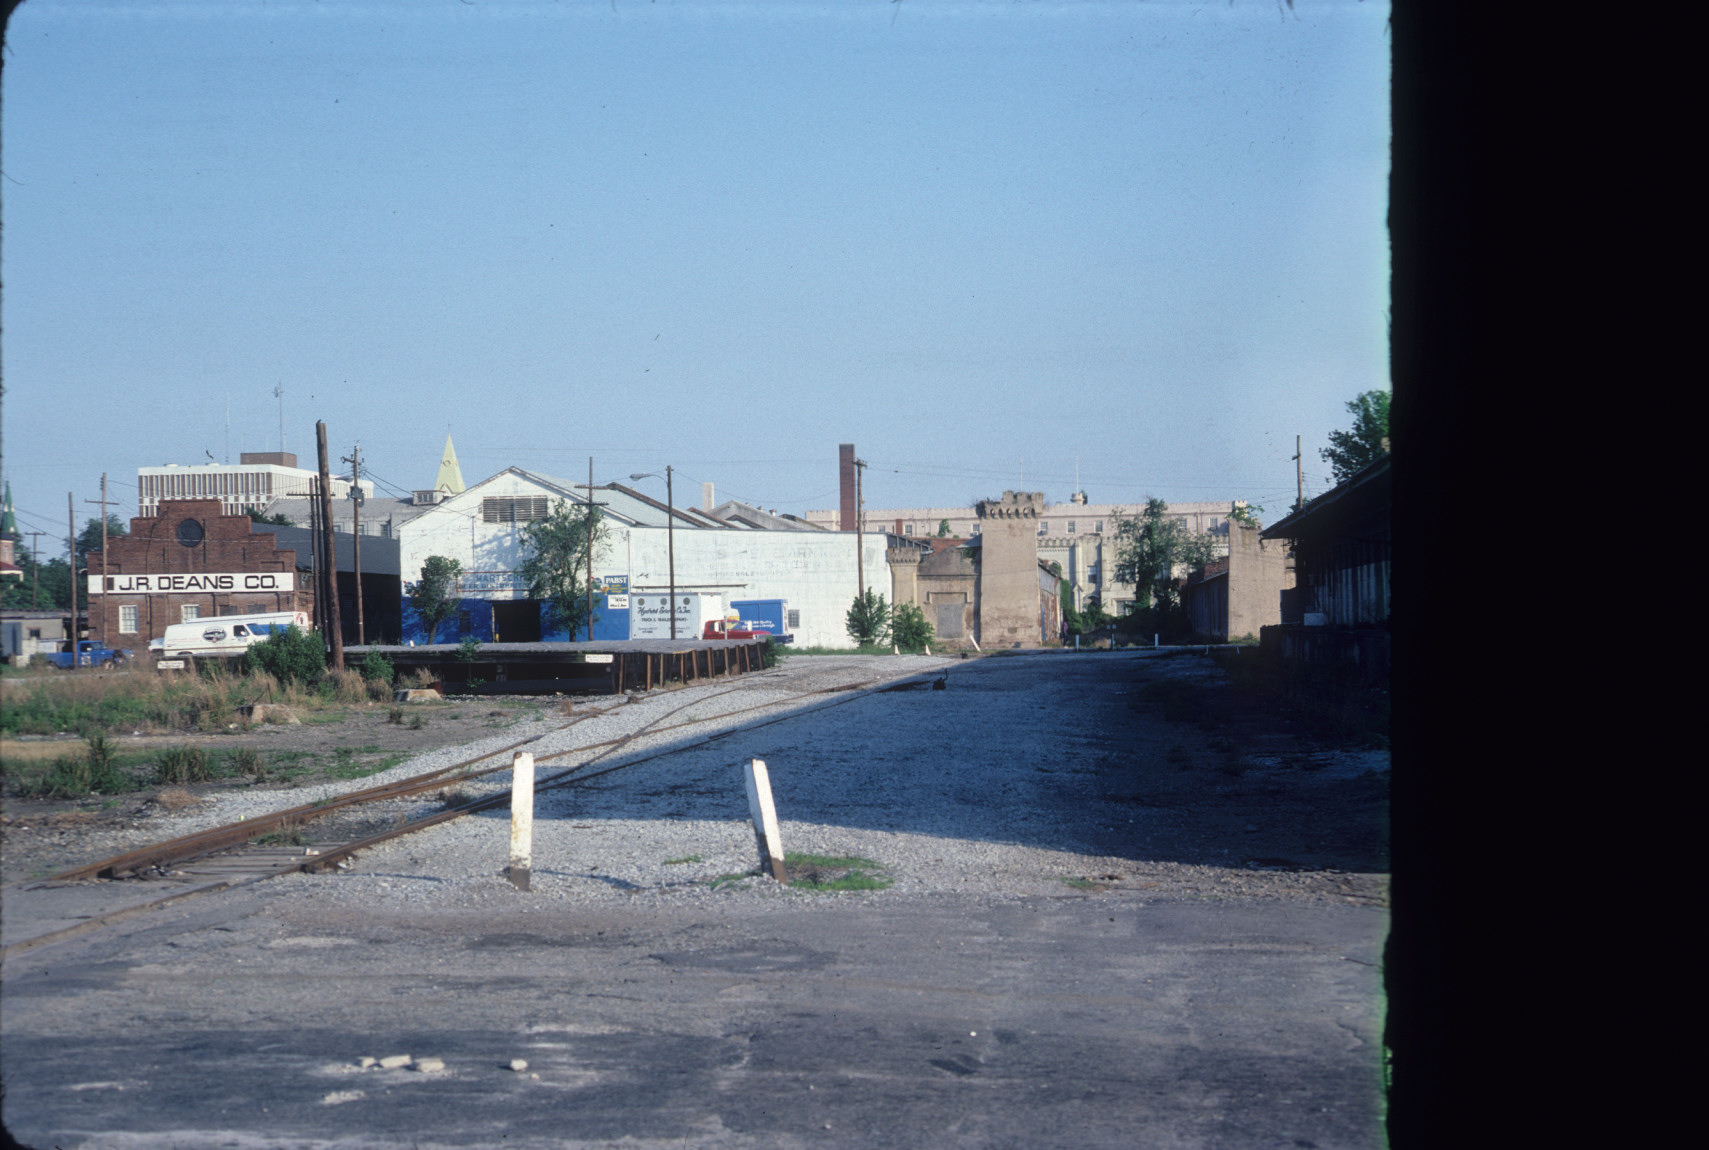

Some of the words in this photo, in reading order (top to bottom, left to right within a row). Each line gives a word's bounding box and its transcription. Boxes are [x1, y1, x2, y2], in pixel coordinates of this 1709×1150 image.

[119, 576, 153, 591] J.R.
[158, 575, 234, 590] DEANS
[244, 575, 279, 589] CO.
